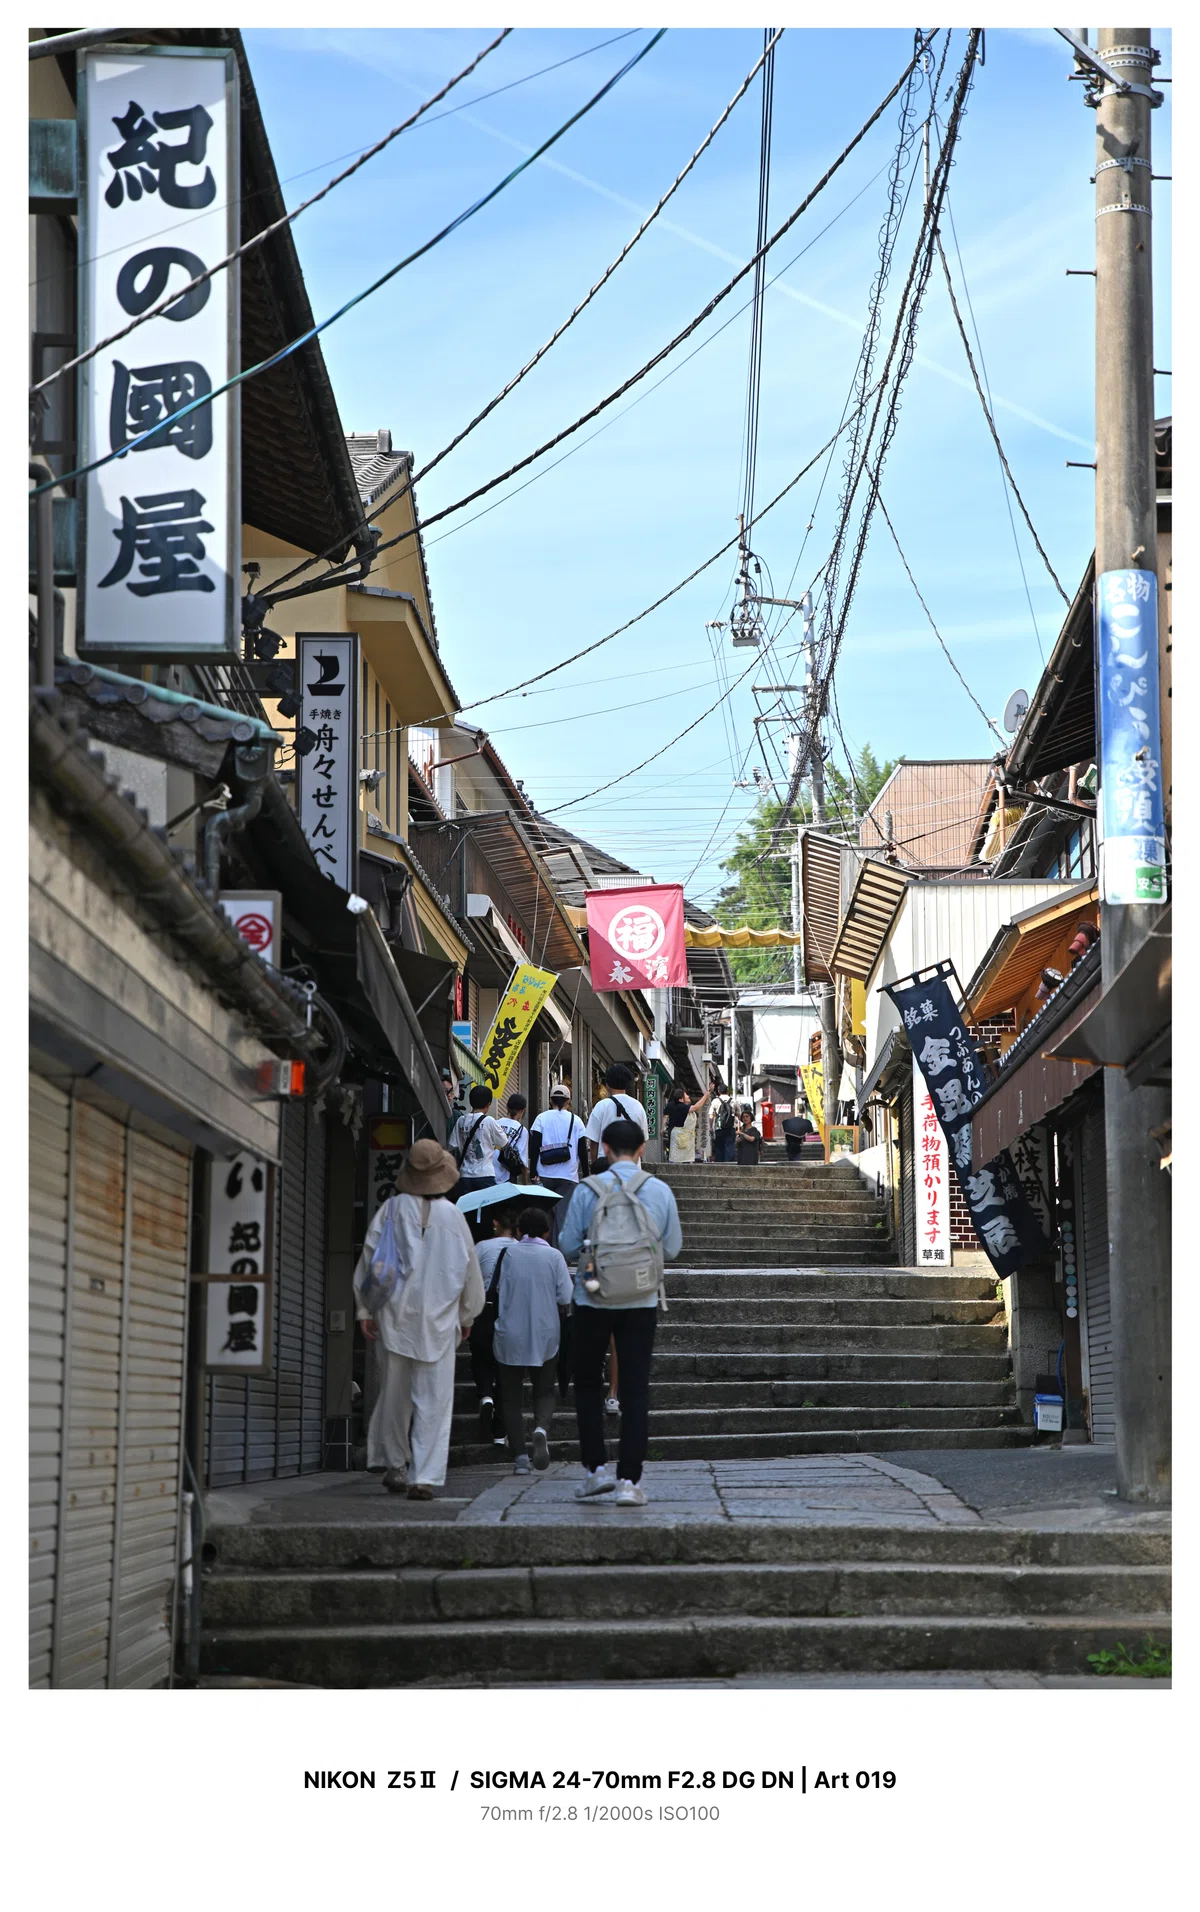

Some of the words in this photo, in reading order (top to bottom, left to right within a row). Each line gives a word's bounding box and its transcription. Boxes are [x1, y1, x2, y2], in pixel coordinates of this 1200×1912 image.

[99, 100, 218, 598] 紀の國屋
[309, 708, 342, 721] 手焼き
[615, 914, 657, 953] 福
[903, 998, 939, 1031] 銘菓
[921, 1093, 941, 1245] 手荷物預かります
